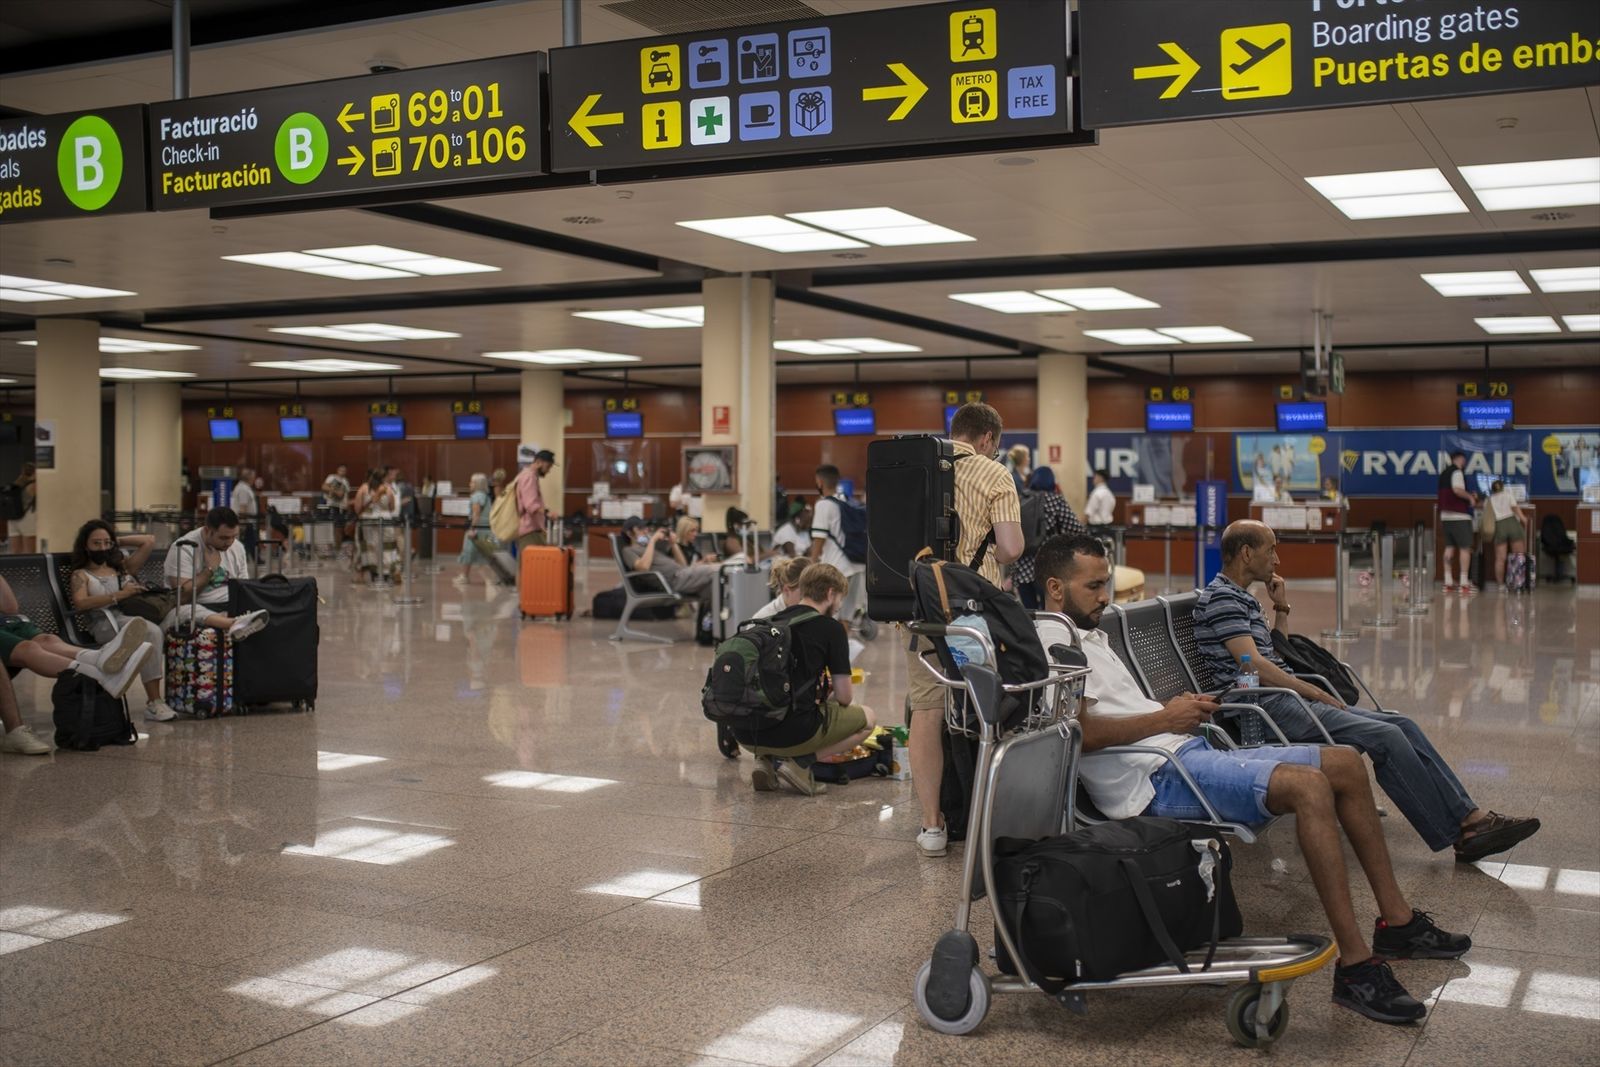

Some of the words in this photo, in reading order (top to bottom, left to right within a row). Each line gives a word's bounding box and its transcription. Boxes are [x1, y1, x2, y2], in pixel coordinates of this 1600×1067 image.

[1313, 15, 1431, 48] Boarding
[1440, 7, 1520, 41] gates
[956, 74, 992, 86] METRO
[1314, 51, 1450, 88] Puertas
[1459, 43, 1503, 75] de
[1019, 75, 1043, 89] TAX
[408, 89, 449, 127] 69
[450, 89, 462, 102] to
[463, 82, 504, 121] 01
[1014, 94, 1049, 109] FREE
[161, 107, 258, 140] Facturació
[75, 136, 104, 191] B
[162, 142, 220, 166] Check-in
[289, 127, 314, 170] B
[408, 133, 450, 171] 70
[451, 133, 463, 146] to
[466, 125, 527, 165] 106
[163, 164, 271, 194] Facturación
[1171, 386, 1190, 401] 68
[1489, 382, 1508, 397] 70
